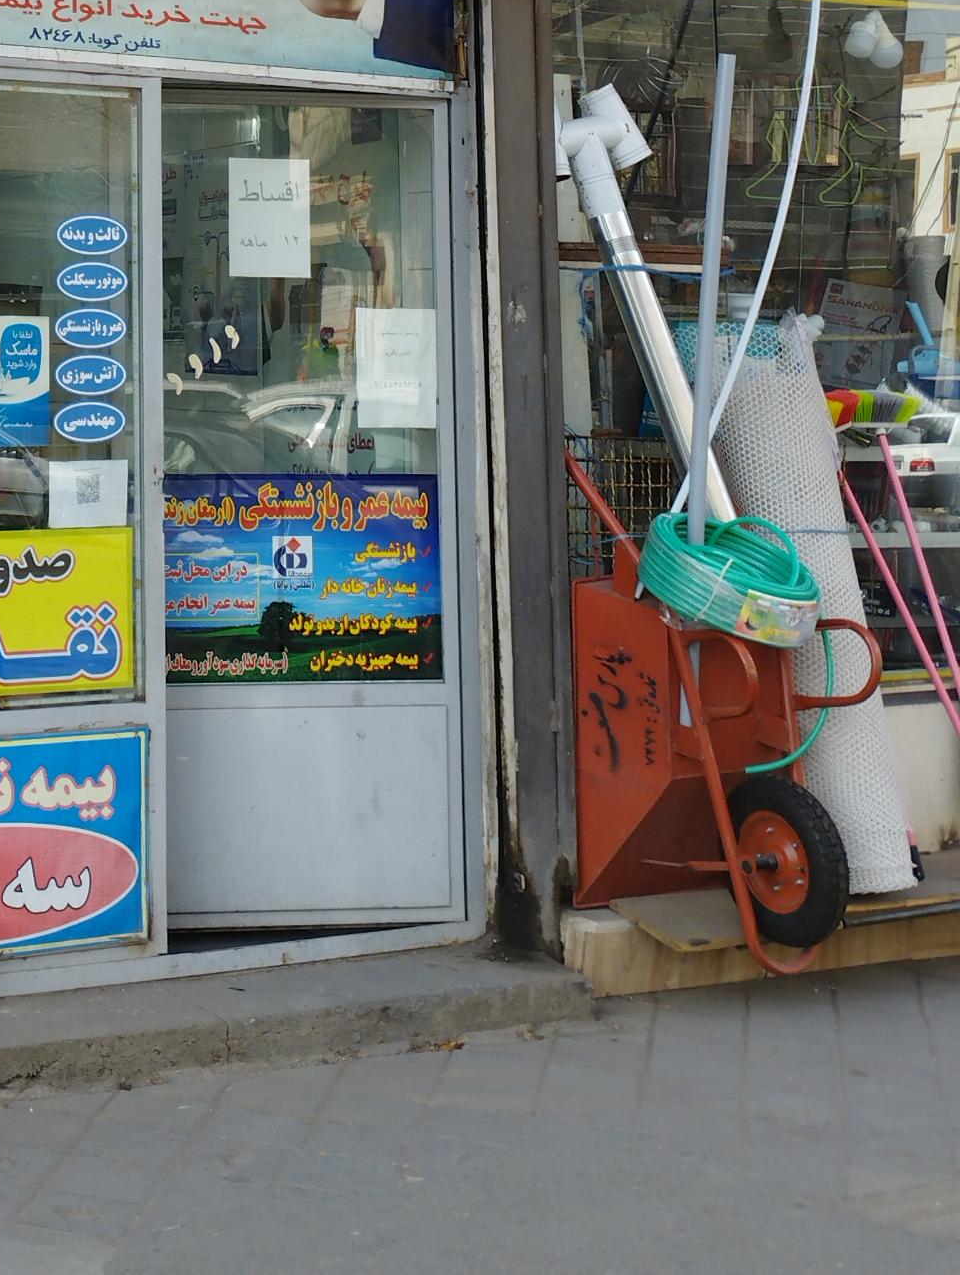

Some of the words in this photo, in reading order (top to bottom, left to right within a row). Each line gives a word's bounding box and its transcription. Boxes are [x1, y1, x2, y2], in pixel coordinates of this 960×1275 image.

[121, 2, 192, 28] خرید
[198, 11, 268, 36] جهت
[124, 37, 162, 53] تلفن
[238, 178, 301, 204] اقساط
[62, 226, 86, 244] بدنه
[86, 232, 95, 245] و
[95, 226, 120, 241] ثالث
[239, 234, 268, 249] ماهه
[284, 233, 301, 246] ۱۲
[63, 272, 96, 288] سیکلت
[96, 273, 123, 289] موتور
[58, 319, 102, 337] بازنشستگی
[101, 324, 108, 336] و
[109, 322, 123, 336] عمر
[5, 340, 39, 357] ماسک
[61, 368, 94, 385] سوزی
[94, 365, 119, 381] آتش
[63, 413, 116, 434] مهندسی
[238, 480, 340, 532] بازنشستگی
[339, 496, 354, 532] و
[353, 490, 390, 532] عمر
[391, 489, 429, 529] بیمه
[354, 541, 417, 564] بازنشستگی
[184, 562, 211, 582] محل
[212, 562, 232, 582] این
[233, 564, 248, 582] در
[320, 577, 339, 600] دار
[340, 576, 366, 595] خانه
[366, 576, 394, 599] زنان
[395, 580, 418, 598] بیمه
[177, 593, 209, 616] انجام
[209, 597, 232, 616] عمر
[233, 597, 257, 614] بیمه
[288, 613, 315, 636] تولد
[315, 616, 337, 635] بدو
[337, 613, 349, 636] از
[349, 613, 394, 636] کودکان
[395, 616, 418, 634] بیمه
[310, 650, 354, 672] دختران
[354, 652, 395, 672] جهیزیه
[395, 652, 419, 670] بیمه
[20, 763, 117, 822] بیمه
[1, 856, 93, 915] سه
